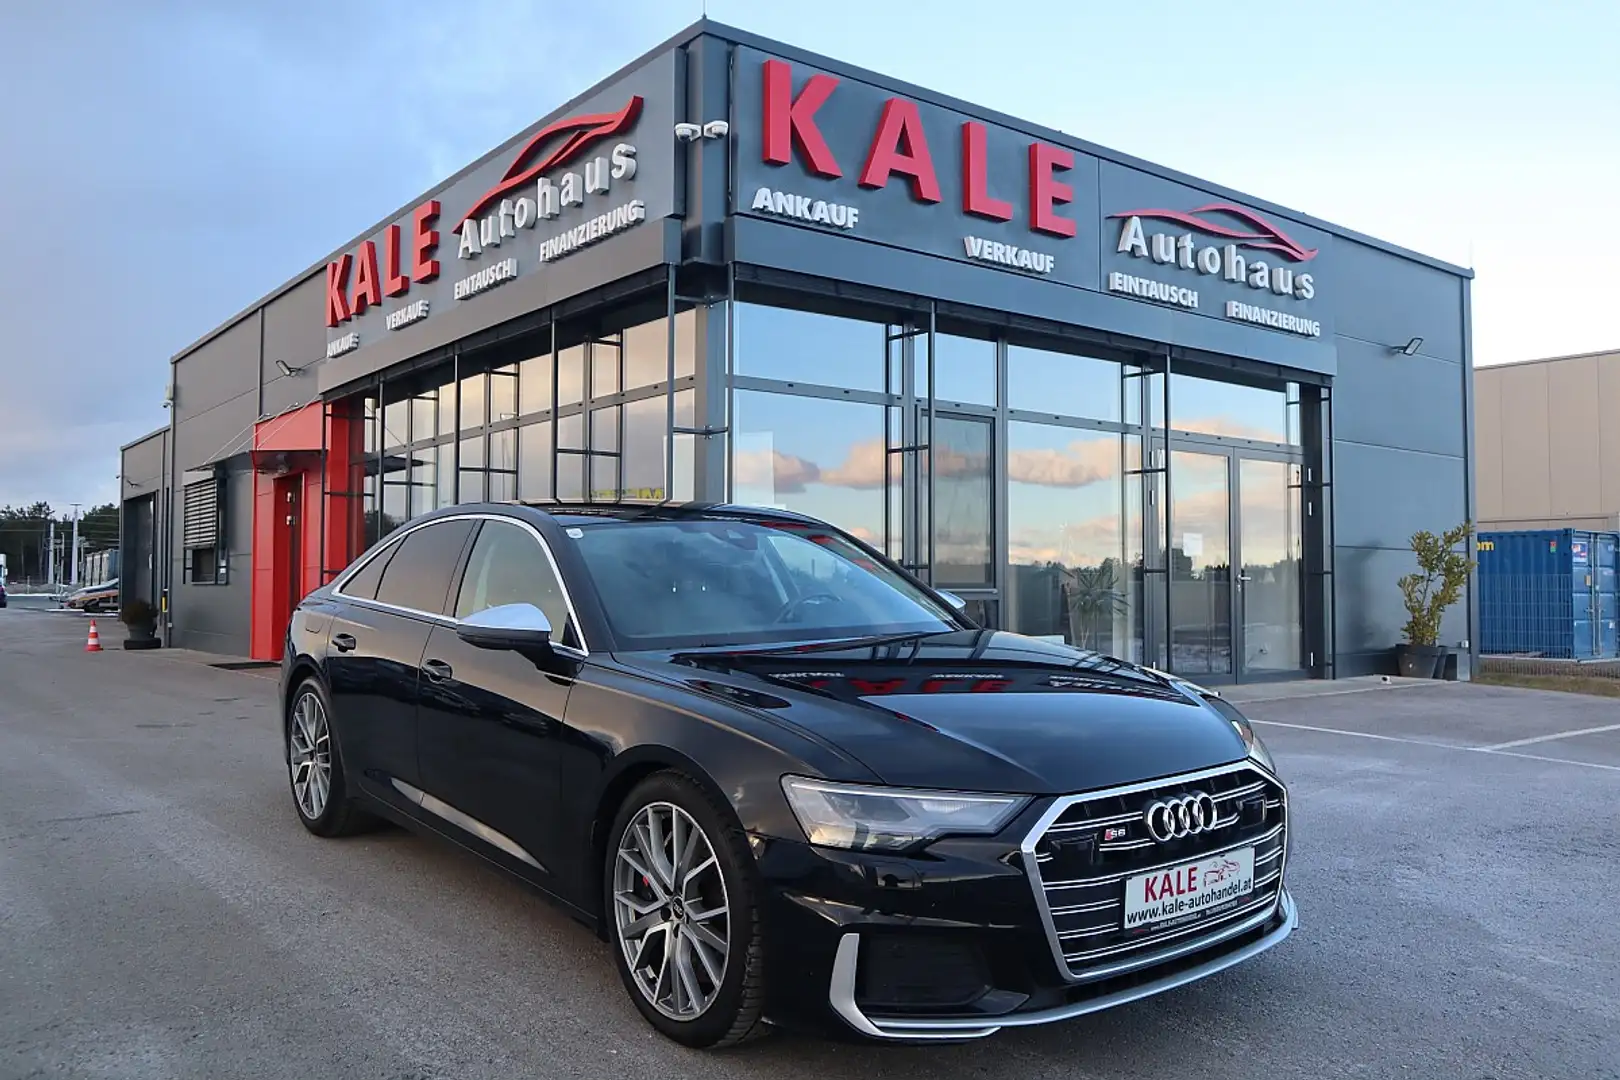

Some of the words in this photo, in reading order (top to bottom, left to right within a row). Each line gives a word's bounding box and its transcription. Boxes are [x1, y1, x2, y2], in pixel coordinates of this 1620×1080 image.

[458, 143, 636, 259] Autohaus
[763, 59, 1076, 238] KALE
[326, 200, 440, 327] KALE
[386, 300, 429, 331] VERKAUF
[454, 258, 517, 300] EINTAUSCH
[540, 200, 645, 262] FINANZIERUNG
[752, 187, 858, 229] ANKAUF
[963, 236, 1054, 273] VERKAUF
[1109, 272, 1198, 308] EINTAUSCH
[1226, 301, 1320, 337] FINANZIERUNG
[1117, 215, 1315, 300] Autohaus
[1127, 877, 1252, 925] www.kale-autohandel.at
[1144, 867, 1198, 903] KALE
